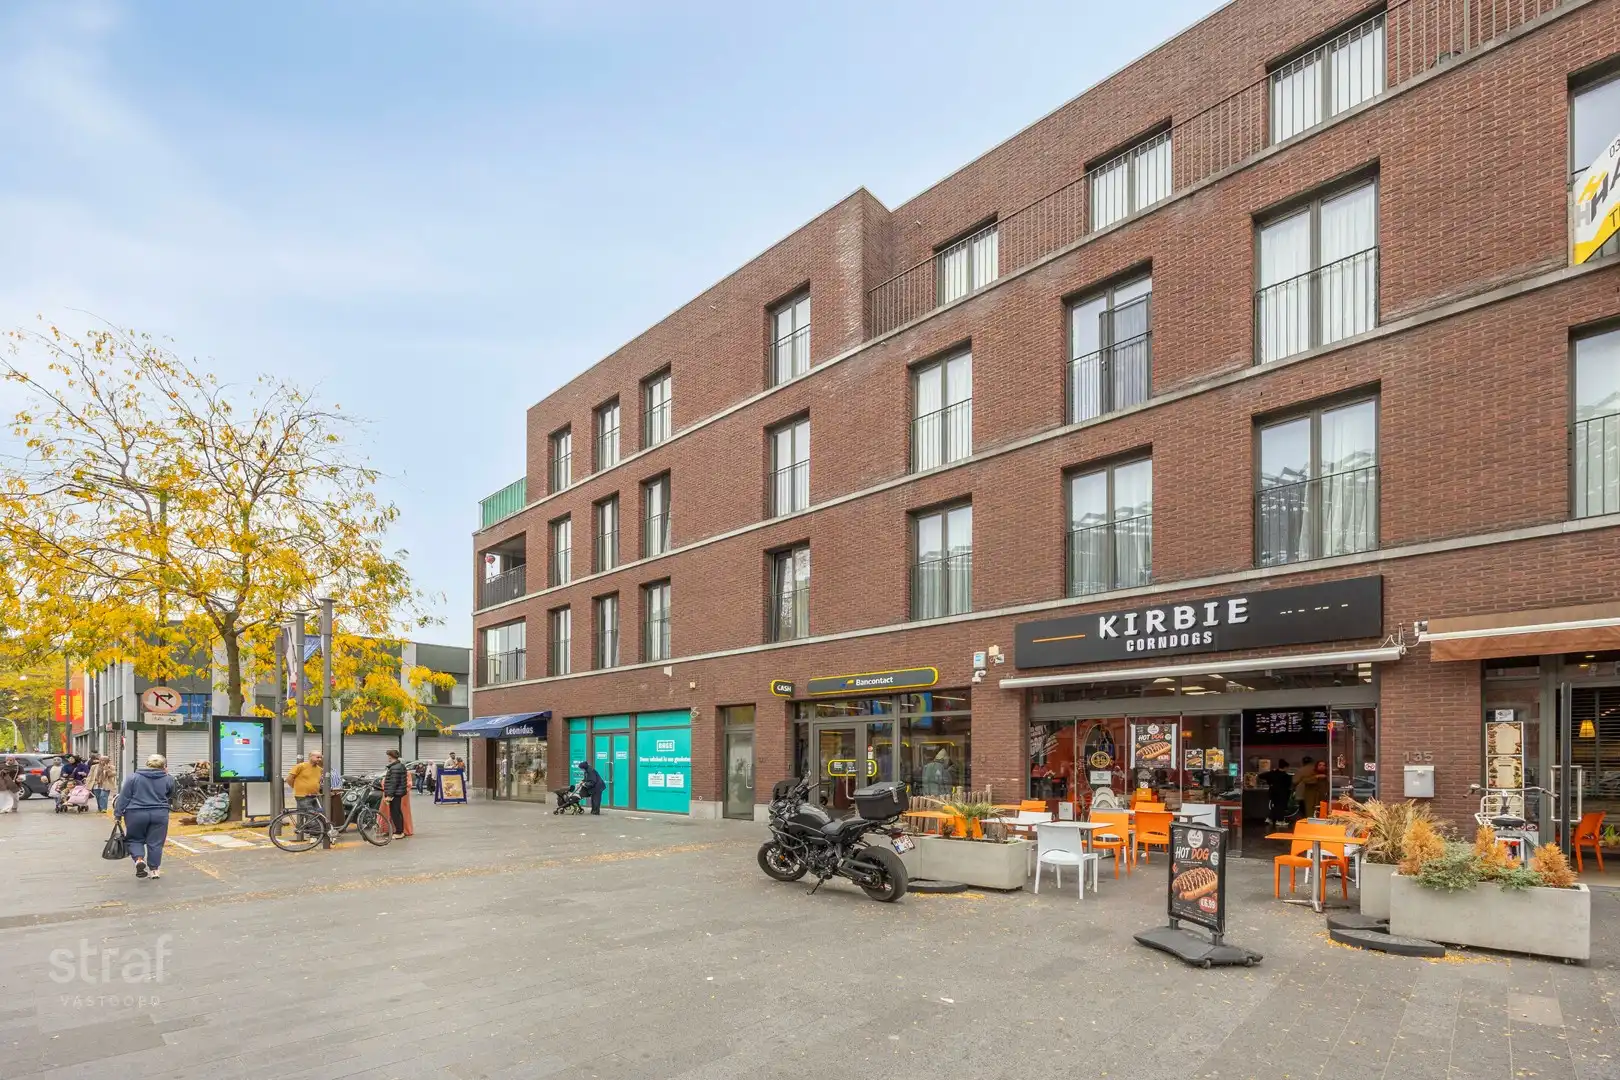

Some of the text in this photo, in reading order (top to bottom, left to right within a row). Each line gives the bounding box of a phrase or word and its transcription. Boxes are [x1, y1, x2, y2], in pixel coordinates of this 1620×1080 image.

[1100, 598, 1248, 639] KIRBIE
[1126, 631, 1213, 652] CORNDOGS
[855, 676, 894, 687] Bancontact
[776, 684, 792, 692] CASH
[505, 724, 534, 736] Leonidas
[1138, 734, 1151, 742] HOT
[1402, 750, 1434, 762] 135
[1175, 846, 1190, 859] HOT
[1191, 847, 1209, 861] DOG
